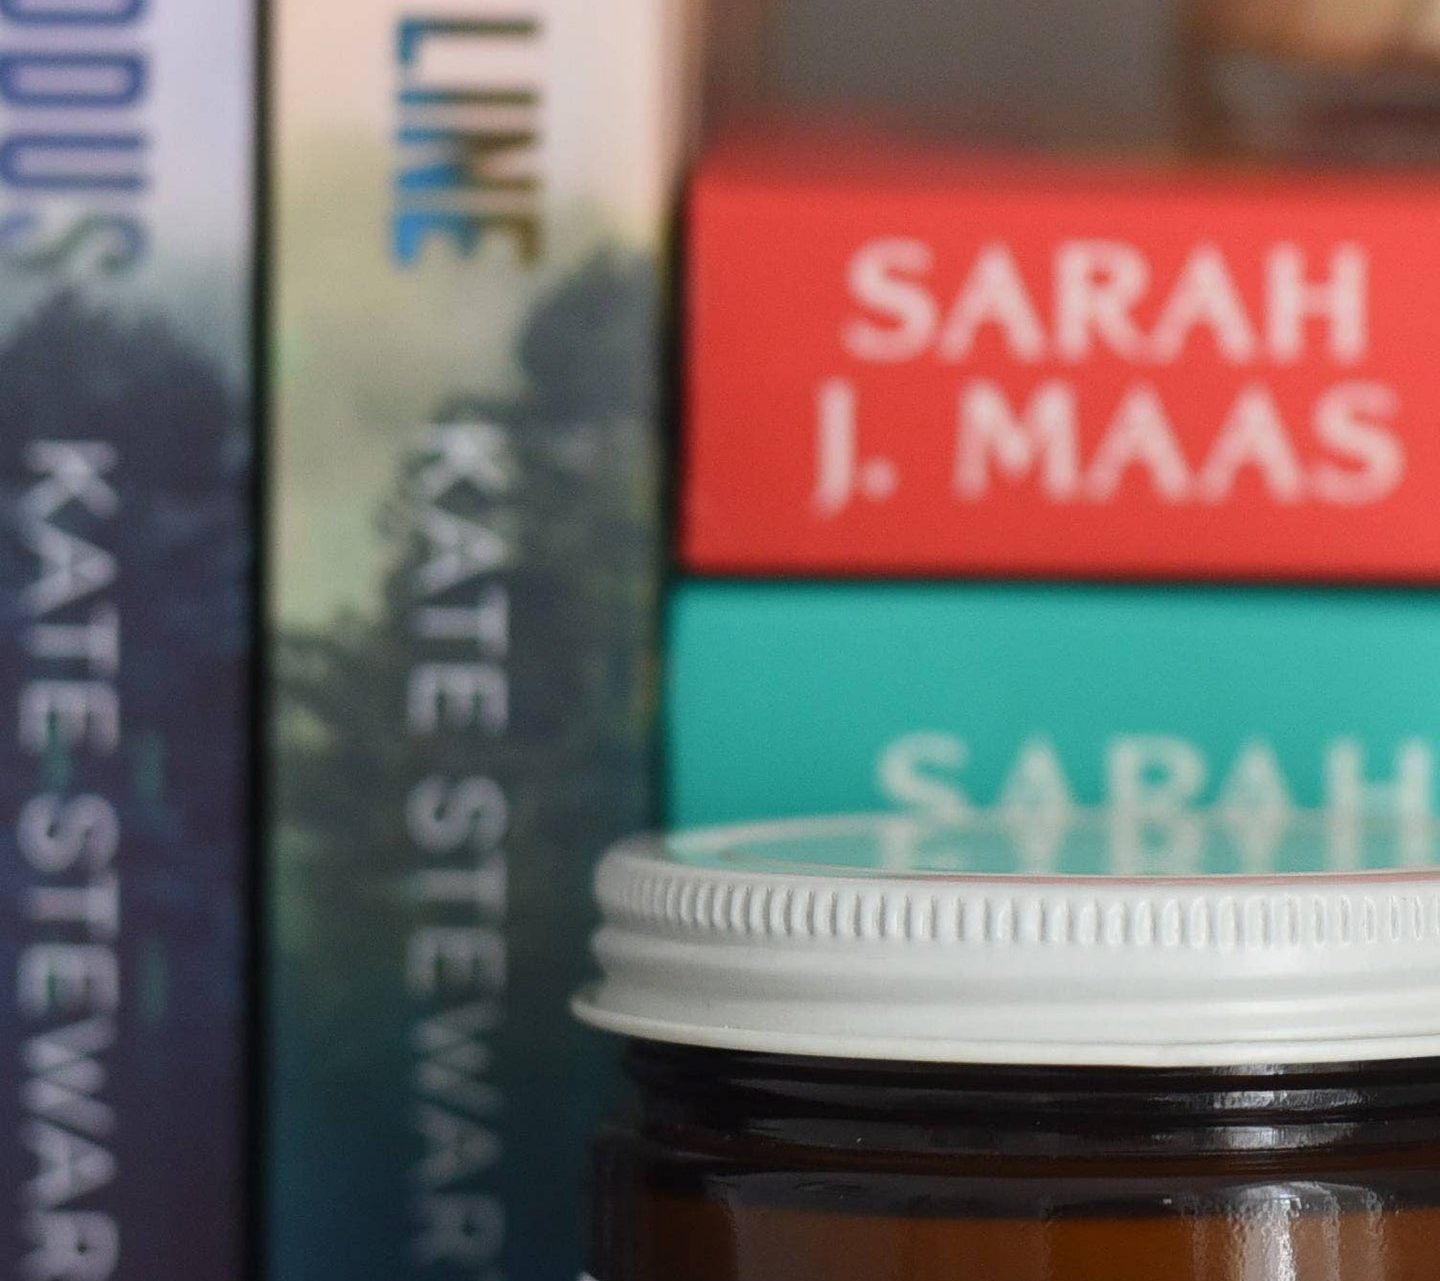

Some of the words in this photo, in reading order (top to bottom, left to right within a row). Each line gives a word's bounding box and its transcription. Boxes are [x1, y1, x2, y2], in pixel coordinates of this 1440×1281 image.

[390, 14, 545, 270] LINE
[841, 238, 1370, 364] SARAH
[811, 378, 899, 519] J.
[955, 380, 1407, 506] MAAS
[18, 441, 119, 756] KATE
[407, 423, 510, 732] KATE
[870, 728, 1438, 818] SARAH
